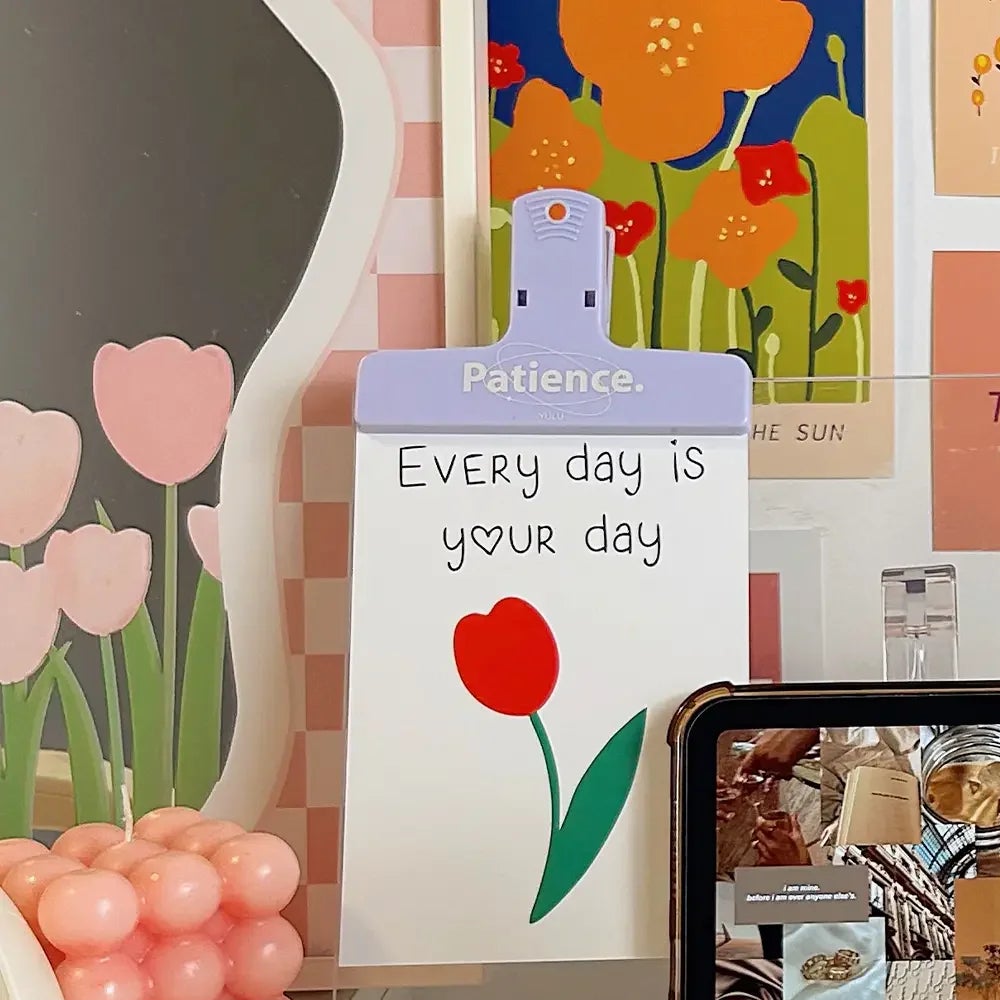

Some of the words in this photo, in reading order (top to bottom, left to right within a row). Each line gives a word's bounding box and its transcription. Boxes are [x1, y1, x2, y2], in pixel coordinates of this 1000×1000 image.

[462, 361, 644, 394] Patience.
[753, 424, 782, 441] HE
[796, 423, 845, 441] SUN
[566, 442, 642, 496] day
[670, 439, 705, 483] is
[585, 513, 662, 567] day
